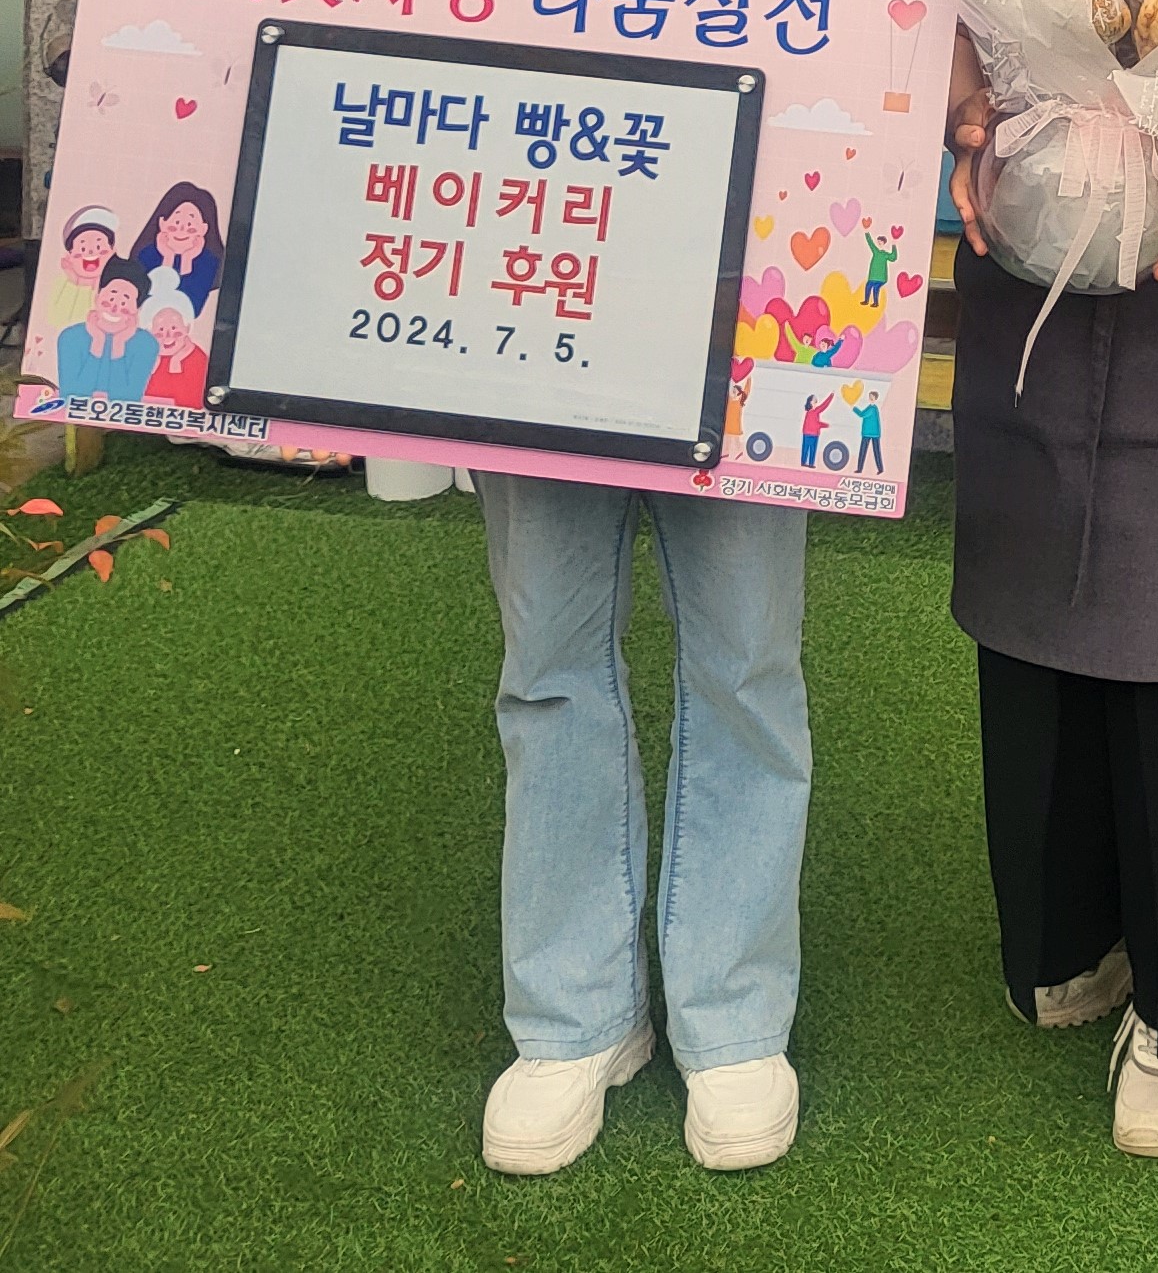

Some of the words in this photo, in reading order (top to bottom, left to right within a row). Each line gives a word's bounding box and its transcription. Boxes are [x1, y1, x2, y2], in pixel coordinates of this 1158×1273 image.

[333, 82, 490, 148] 날마다
[514, 102, 672, 181] 빵&꽃
[364, 163, 613, 243] 베이커리
[359, 232, 466, 302] 정기
[490, 245, 600, 321] 후원
[349, 308, 468, 354] 2024.
[495, 325, 528, 361] 7.
[554, 333, 590, 368] 5.
[67, 396, 269, 441] 본오2동행정복지센터
[720, 477, 752, 496] 경기
[757, 481, 895, 511] 사회복지공동모금회
